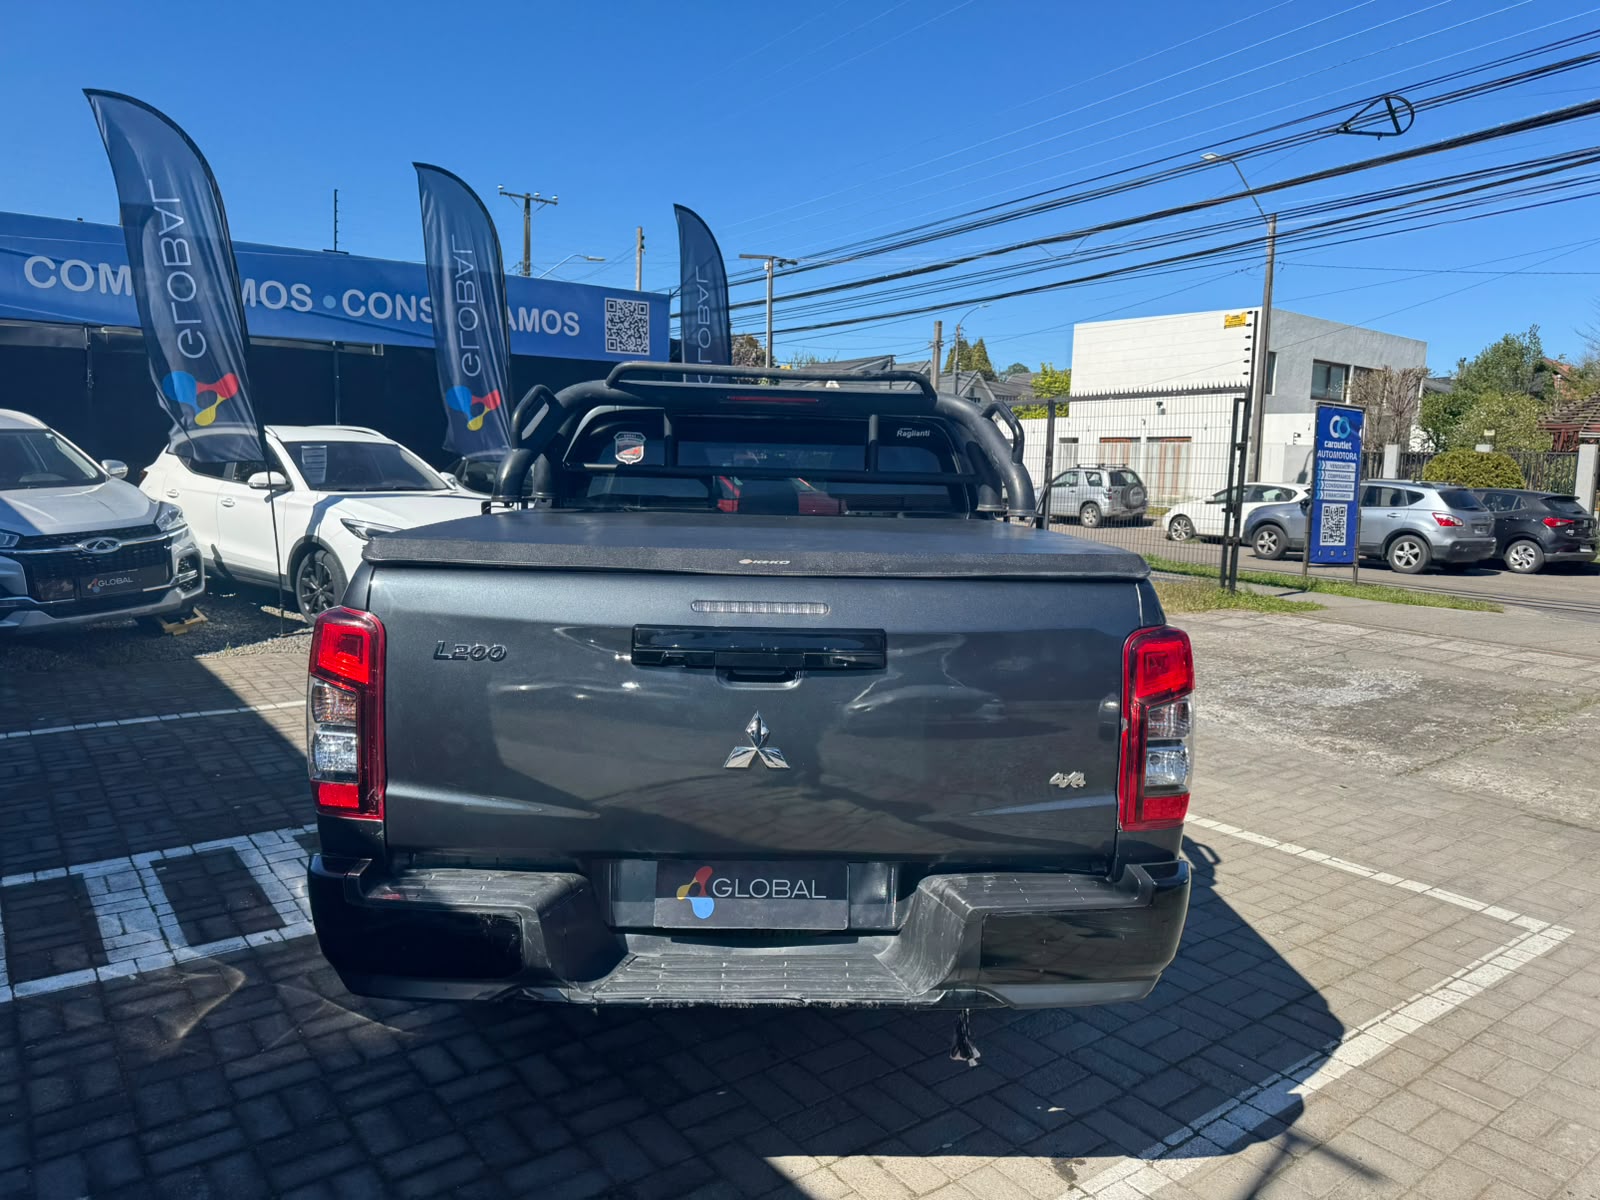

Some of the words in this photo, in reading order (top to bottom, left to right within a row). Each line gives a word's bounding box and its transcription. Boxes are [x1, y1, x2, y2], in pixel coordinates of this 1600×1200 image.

[24, 255, 313, 312] COMMOS
[1324, 440, 1352, 450] caroutlet
[1317, 450, 1357, 460] AUTOMOTORA
[97, 577, 134, 587] GLOBAL
[433, 640, 508, 662] L200
[712, 877, 827, 899] GLOBAL
